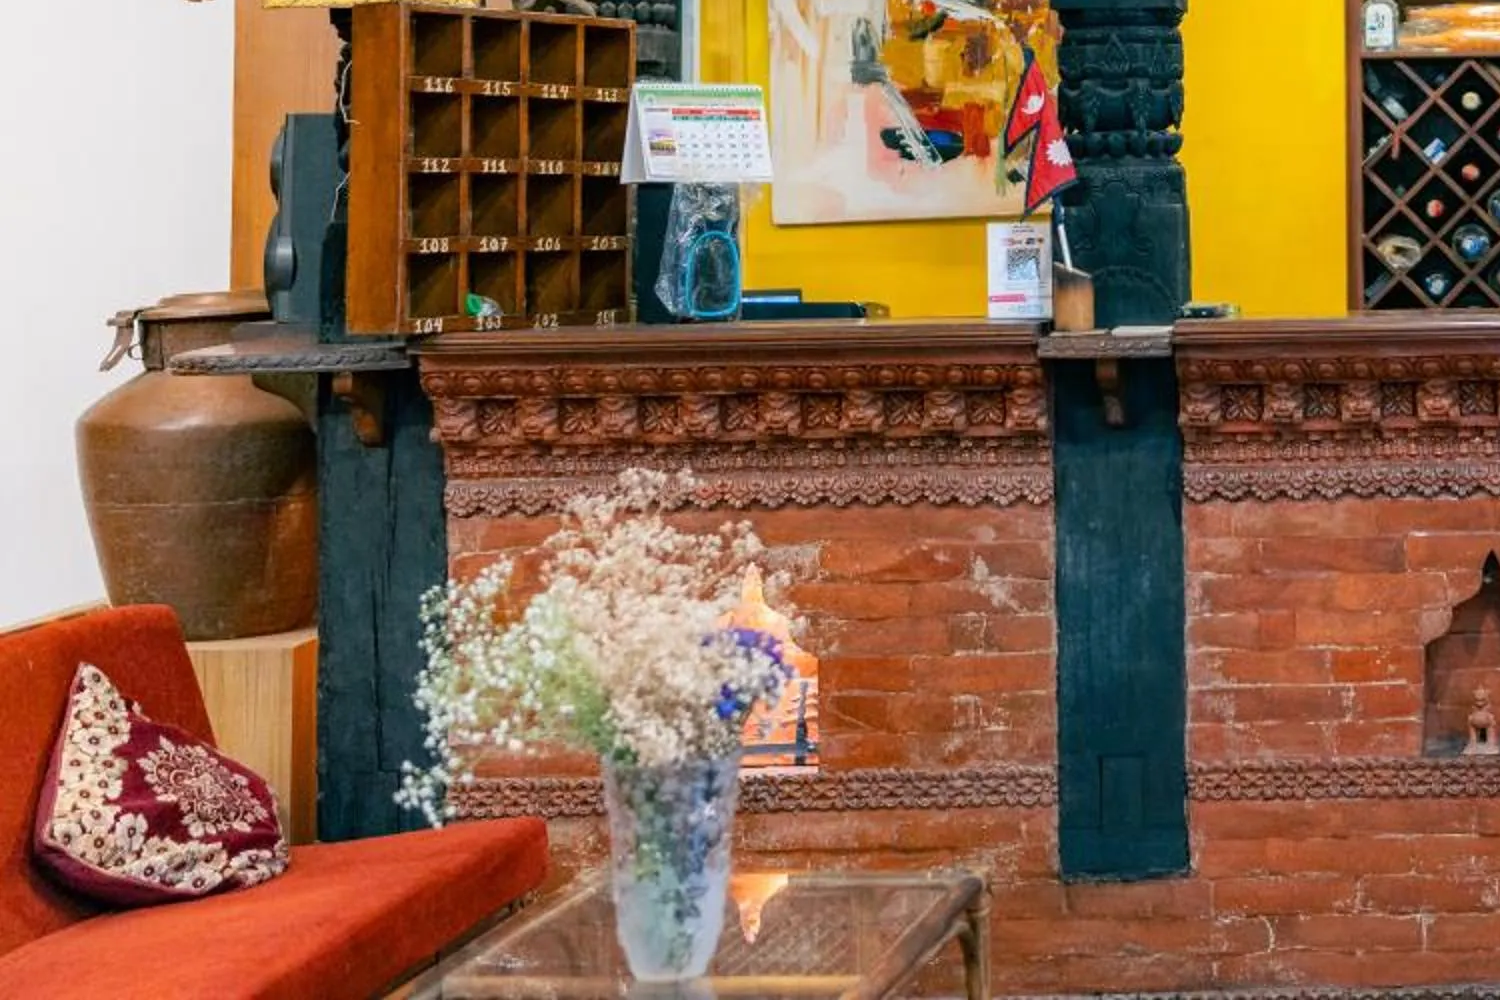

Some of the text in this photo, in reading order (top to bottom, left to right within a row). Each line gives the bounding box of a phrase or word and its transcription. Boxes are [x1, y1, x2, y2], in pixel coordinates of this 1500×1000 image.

[423, 78, 453, 93] 116
[482, 81, 511, 96] 115
[541, 85, 569, 100] 114
[421, 159, 449, 173] 112
[482, 160, 508, 173] 111
[539, 161, 564, 175] 110
[420, 238, 449, 253] 108
[479, 237, 509, 252] 107
[534, 237, 561, 251] 106
[414, 317, 443, 334] 104
[474, 315, 502, 331] 103
[533, 312, 560, 329] 102
